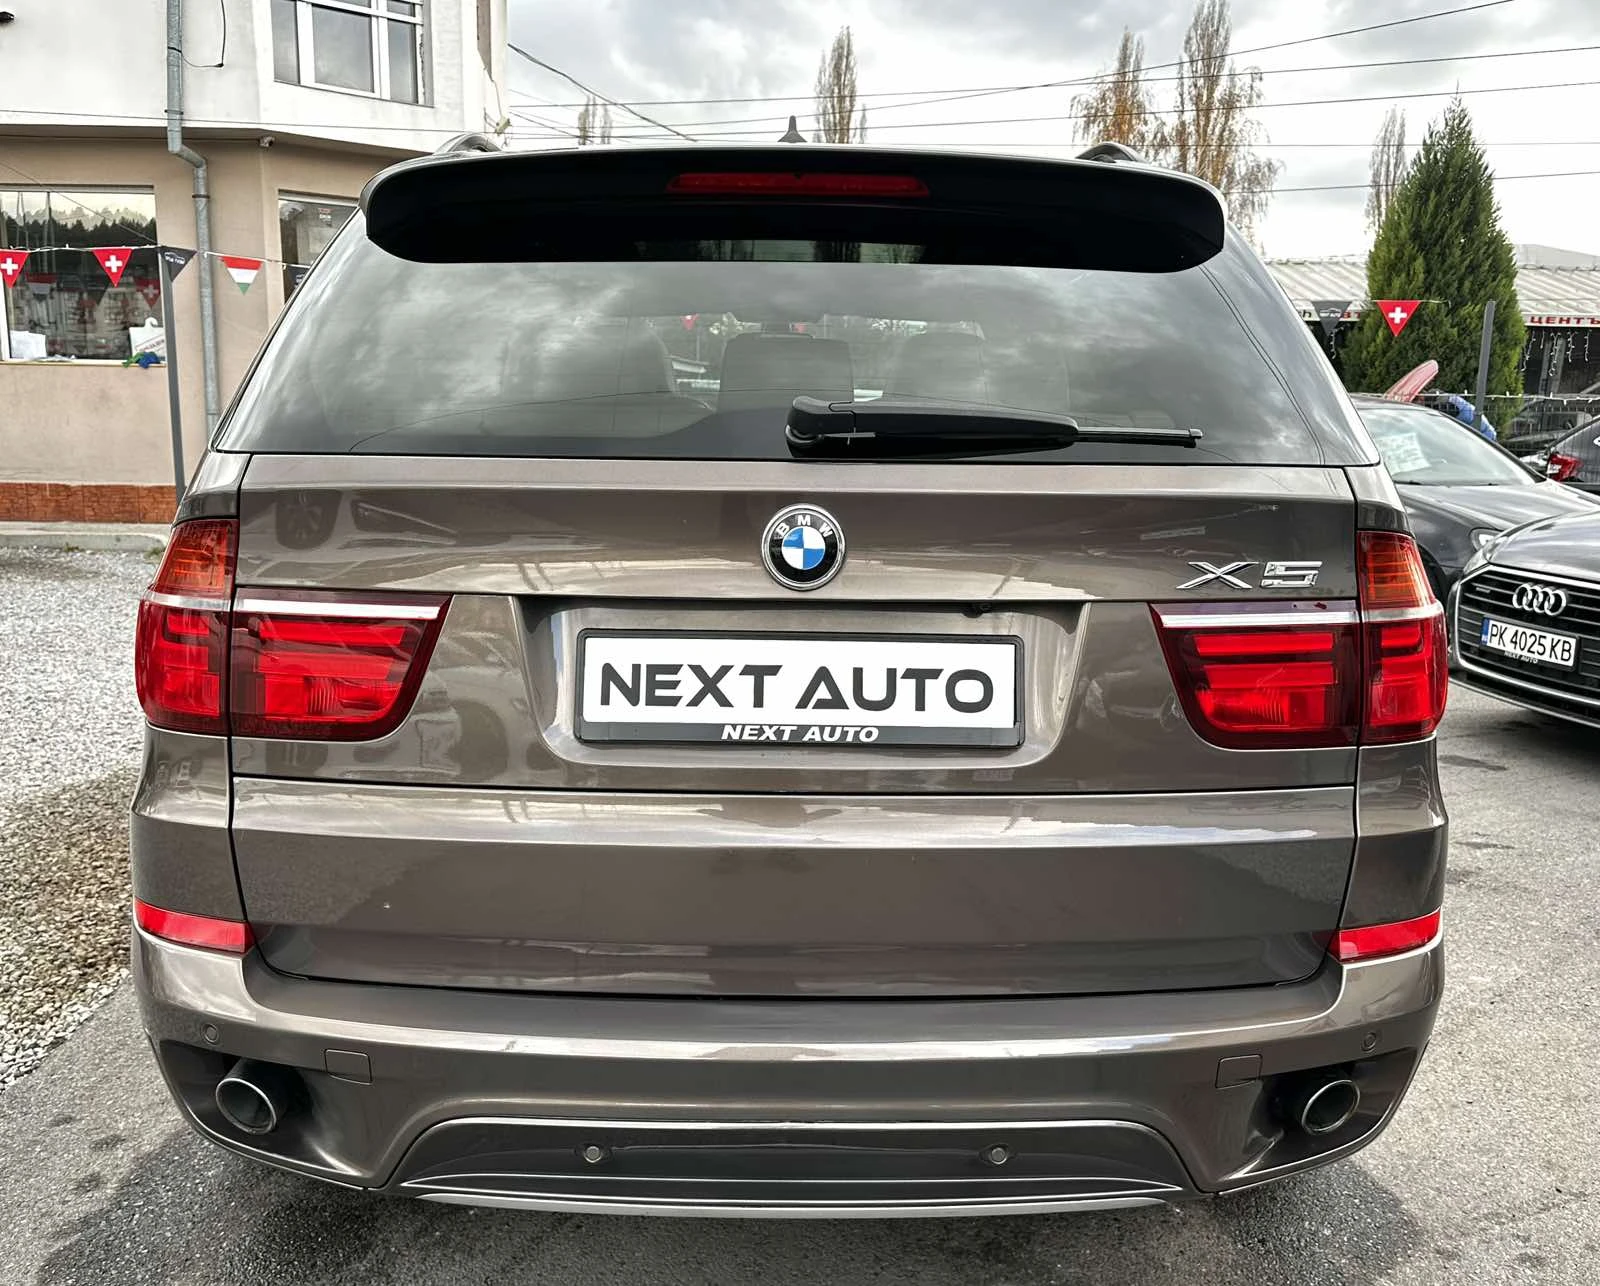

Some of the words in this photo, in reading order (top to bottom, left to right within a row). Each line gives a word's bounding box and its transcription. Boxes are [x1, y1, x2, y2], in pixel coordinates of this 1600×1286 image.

[775, 514, 833, 539] BMW
[1176, 561, 1323, 589] X5
[1489, 624, 1508, 647] PK
[1510, 629, 1546, 656] 4025
[1549, 637, 1572, 662] KB
[600, 662, 783, 708] NEXT
[795, 665, 994, 714] AUTO
[721, 724, 798, 741] NEXT
[802, 726, 879, 742] AUTO
